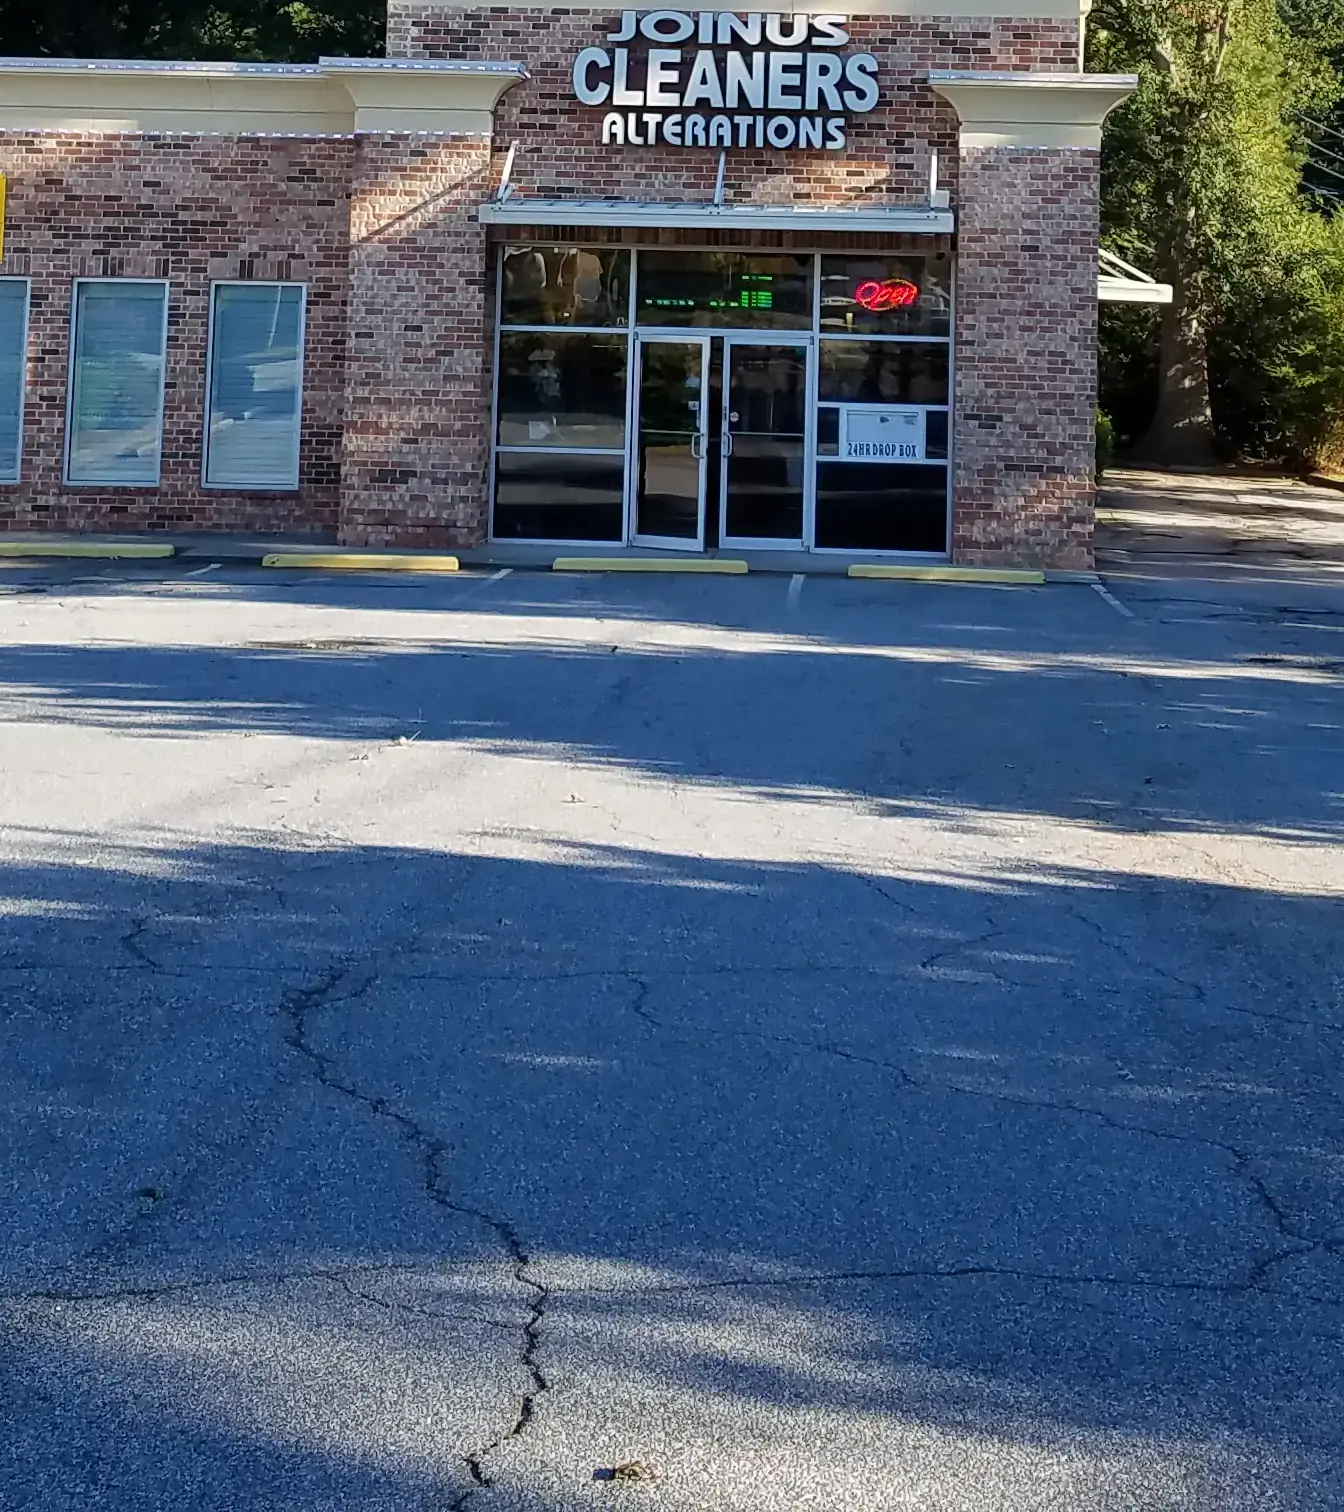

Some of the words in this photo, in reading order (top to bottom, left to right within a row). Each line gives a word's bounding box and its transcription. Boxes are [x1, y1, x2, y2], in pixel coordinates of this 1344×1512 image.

[606, 9, 850, 47] JOINUS
[571, 46, 880, 113] CLEANERS
[601, 111, 846, 150] ALTERATIONS
[873, 444, 897, 456] DROP
[899, 445, 917, 457] BOX
